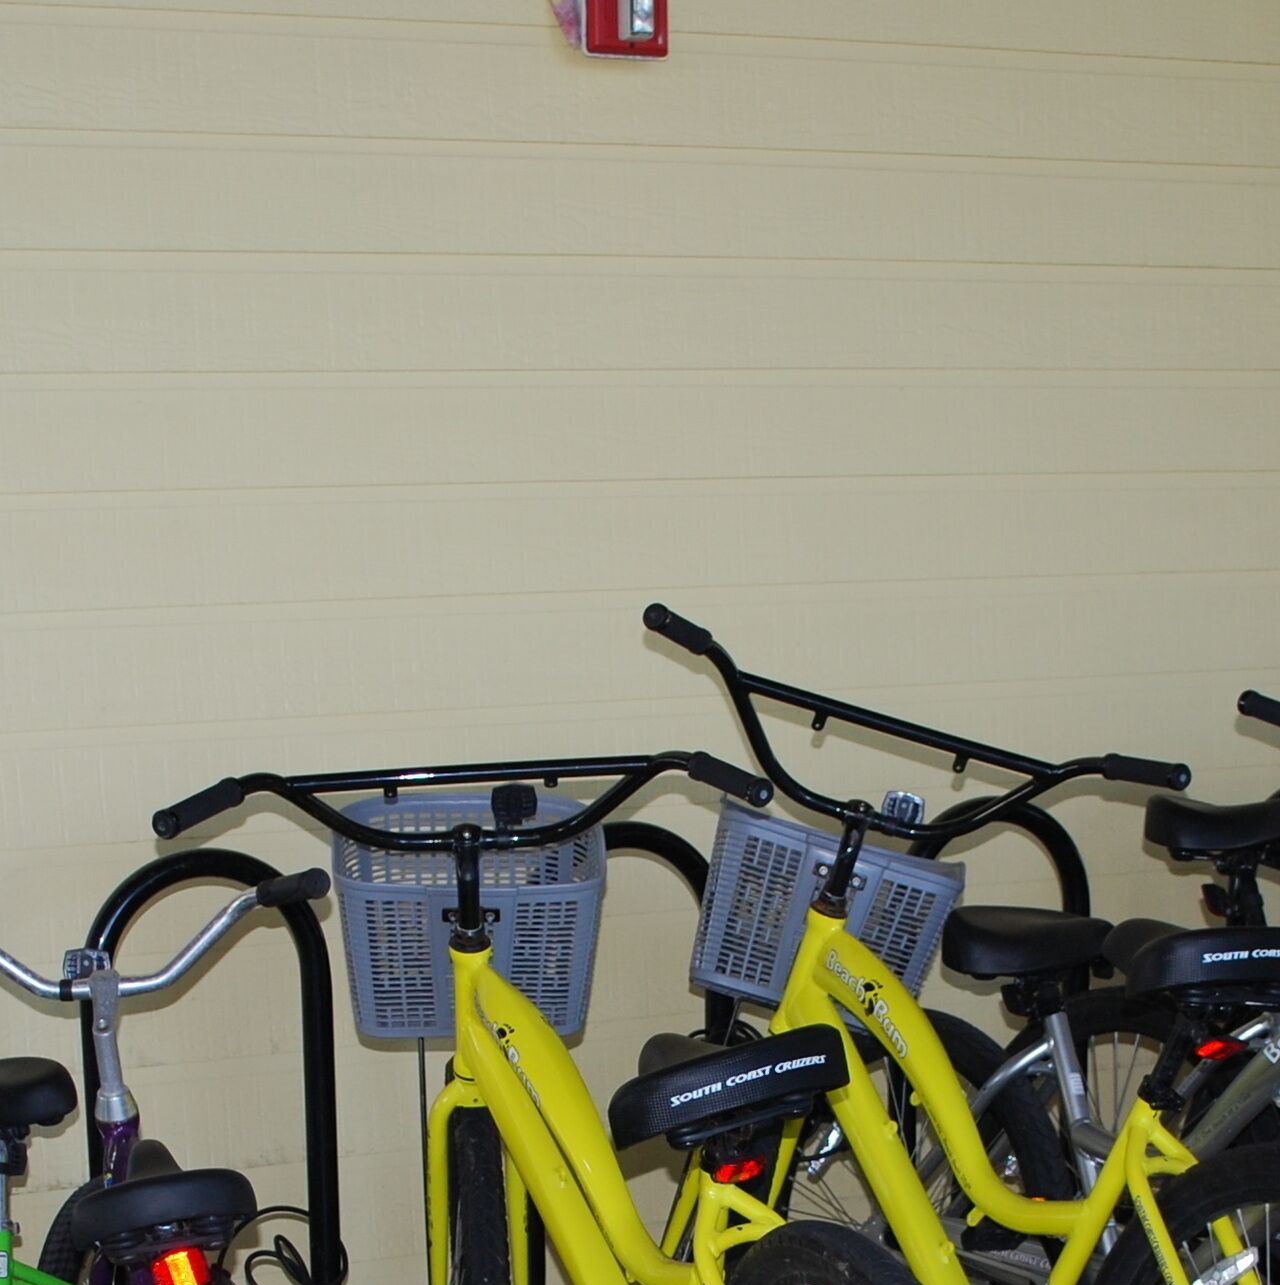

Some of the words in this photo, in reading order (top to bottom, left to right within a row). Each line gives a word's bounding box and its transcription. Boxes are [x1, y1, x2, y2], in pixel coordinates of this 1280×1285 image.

[1202, 950, 1249, 964] SOUTH
[825, 949, 866, 1002] Beach
[872, 1000, 908, 1058] Bum
[670, 1081, 723, 1108] SOUTH
[725, 1065, 773, 1088] COAST
